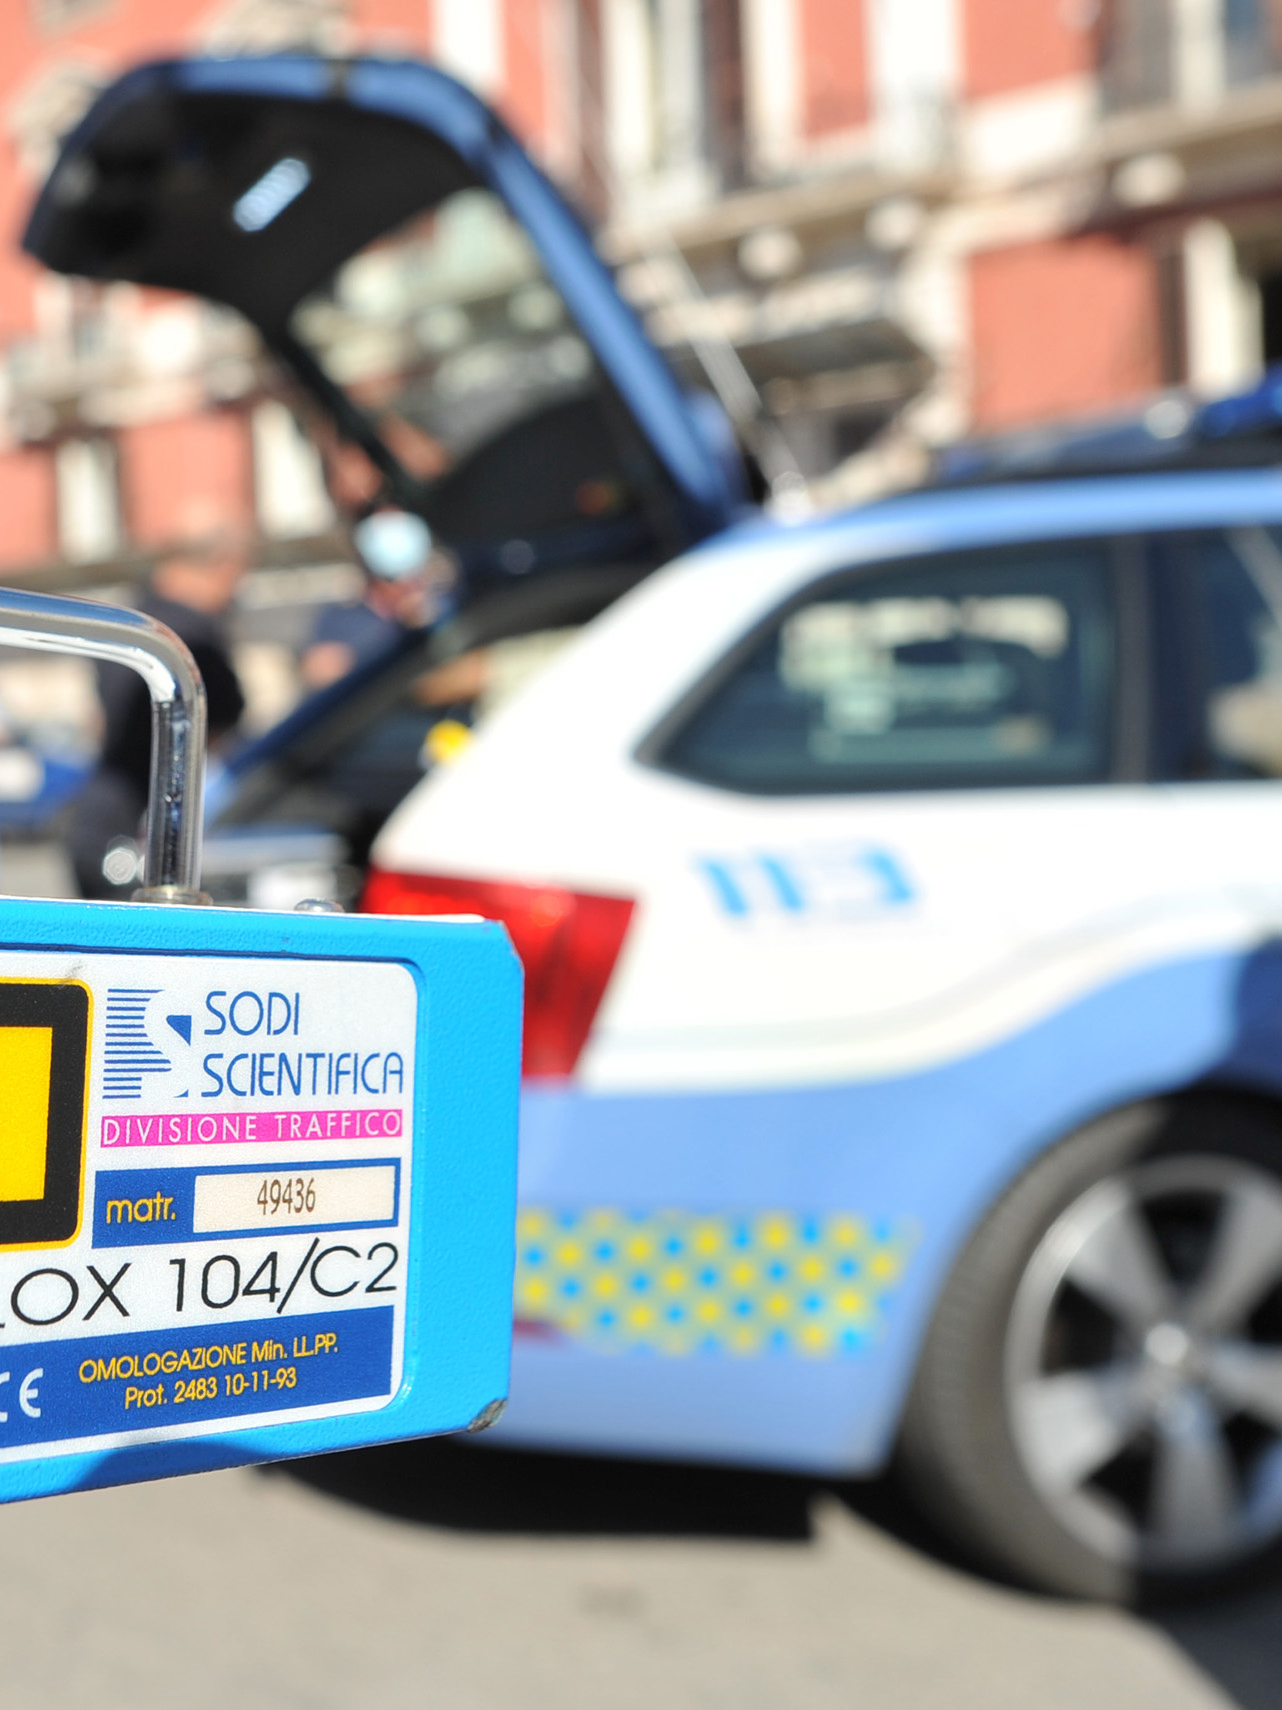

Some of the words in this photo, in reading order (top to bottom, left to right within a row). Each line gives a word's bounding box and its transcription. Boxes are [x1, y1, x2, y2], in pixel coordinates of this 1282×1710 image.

[204, 990, 300, 1036] SODI
[201, 1052, 404, 1098] SCIENTIFICA
[103, 1115, 257, 1145] DIVISIONE
[275, 1111, 401, 1139] TRAFFICO
[106, 1192, 176, 1224] matr.
[257, 1177, 316, 1215] 49436
[169, 1237, 399, 1315] 104/C2
[78, 1345, 247, 1383] OMOLOGAZIONE
[251, 1340, 287, 1363] Min.
[125, 1386, 168, 1410] Prot.
[174, 1381, 217, 1404] 2483
[224, 1368, 296, 1397] 10-11-93
